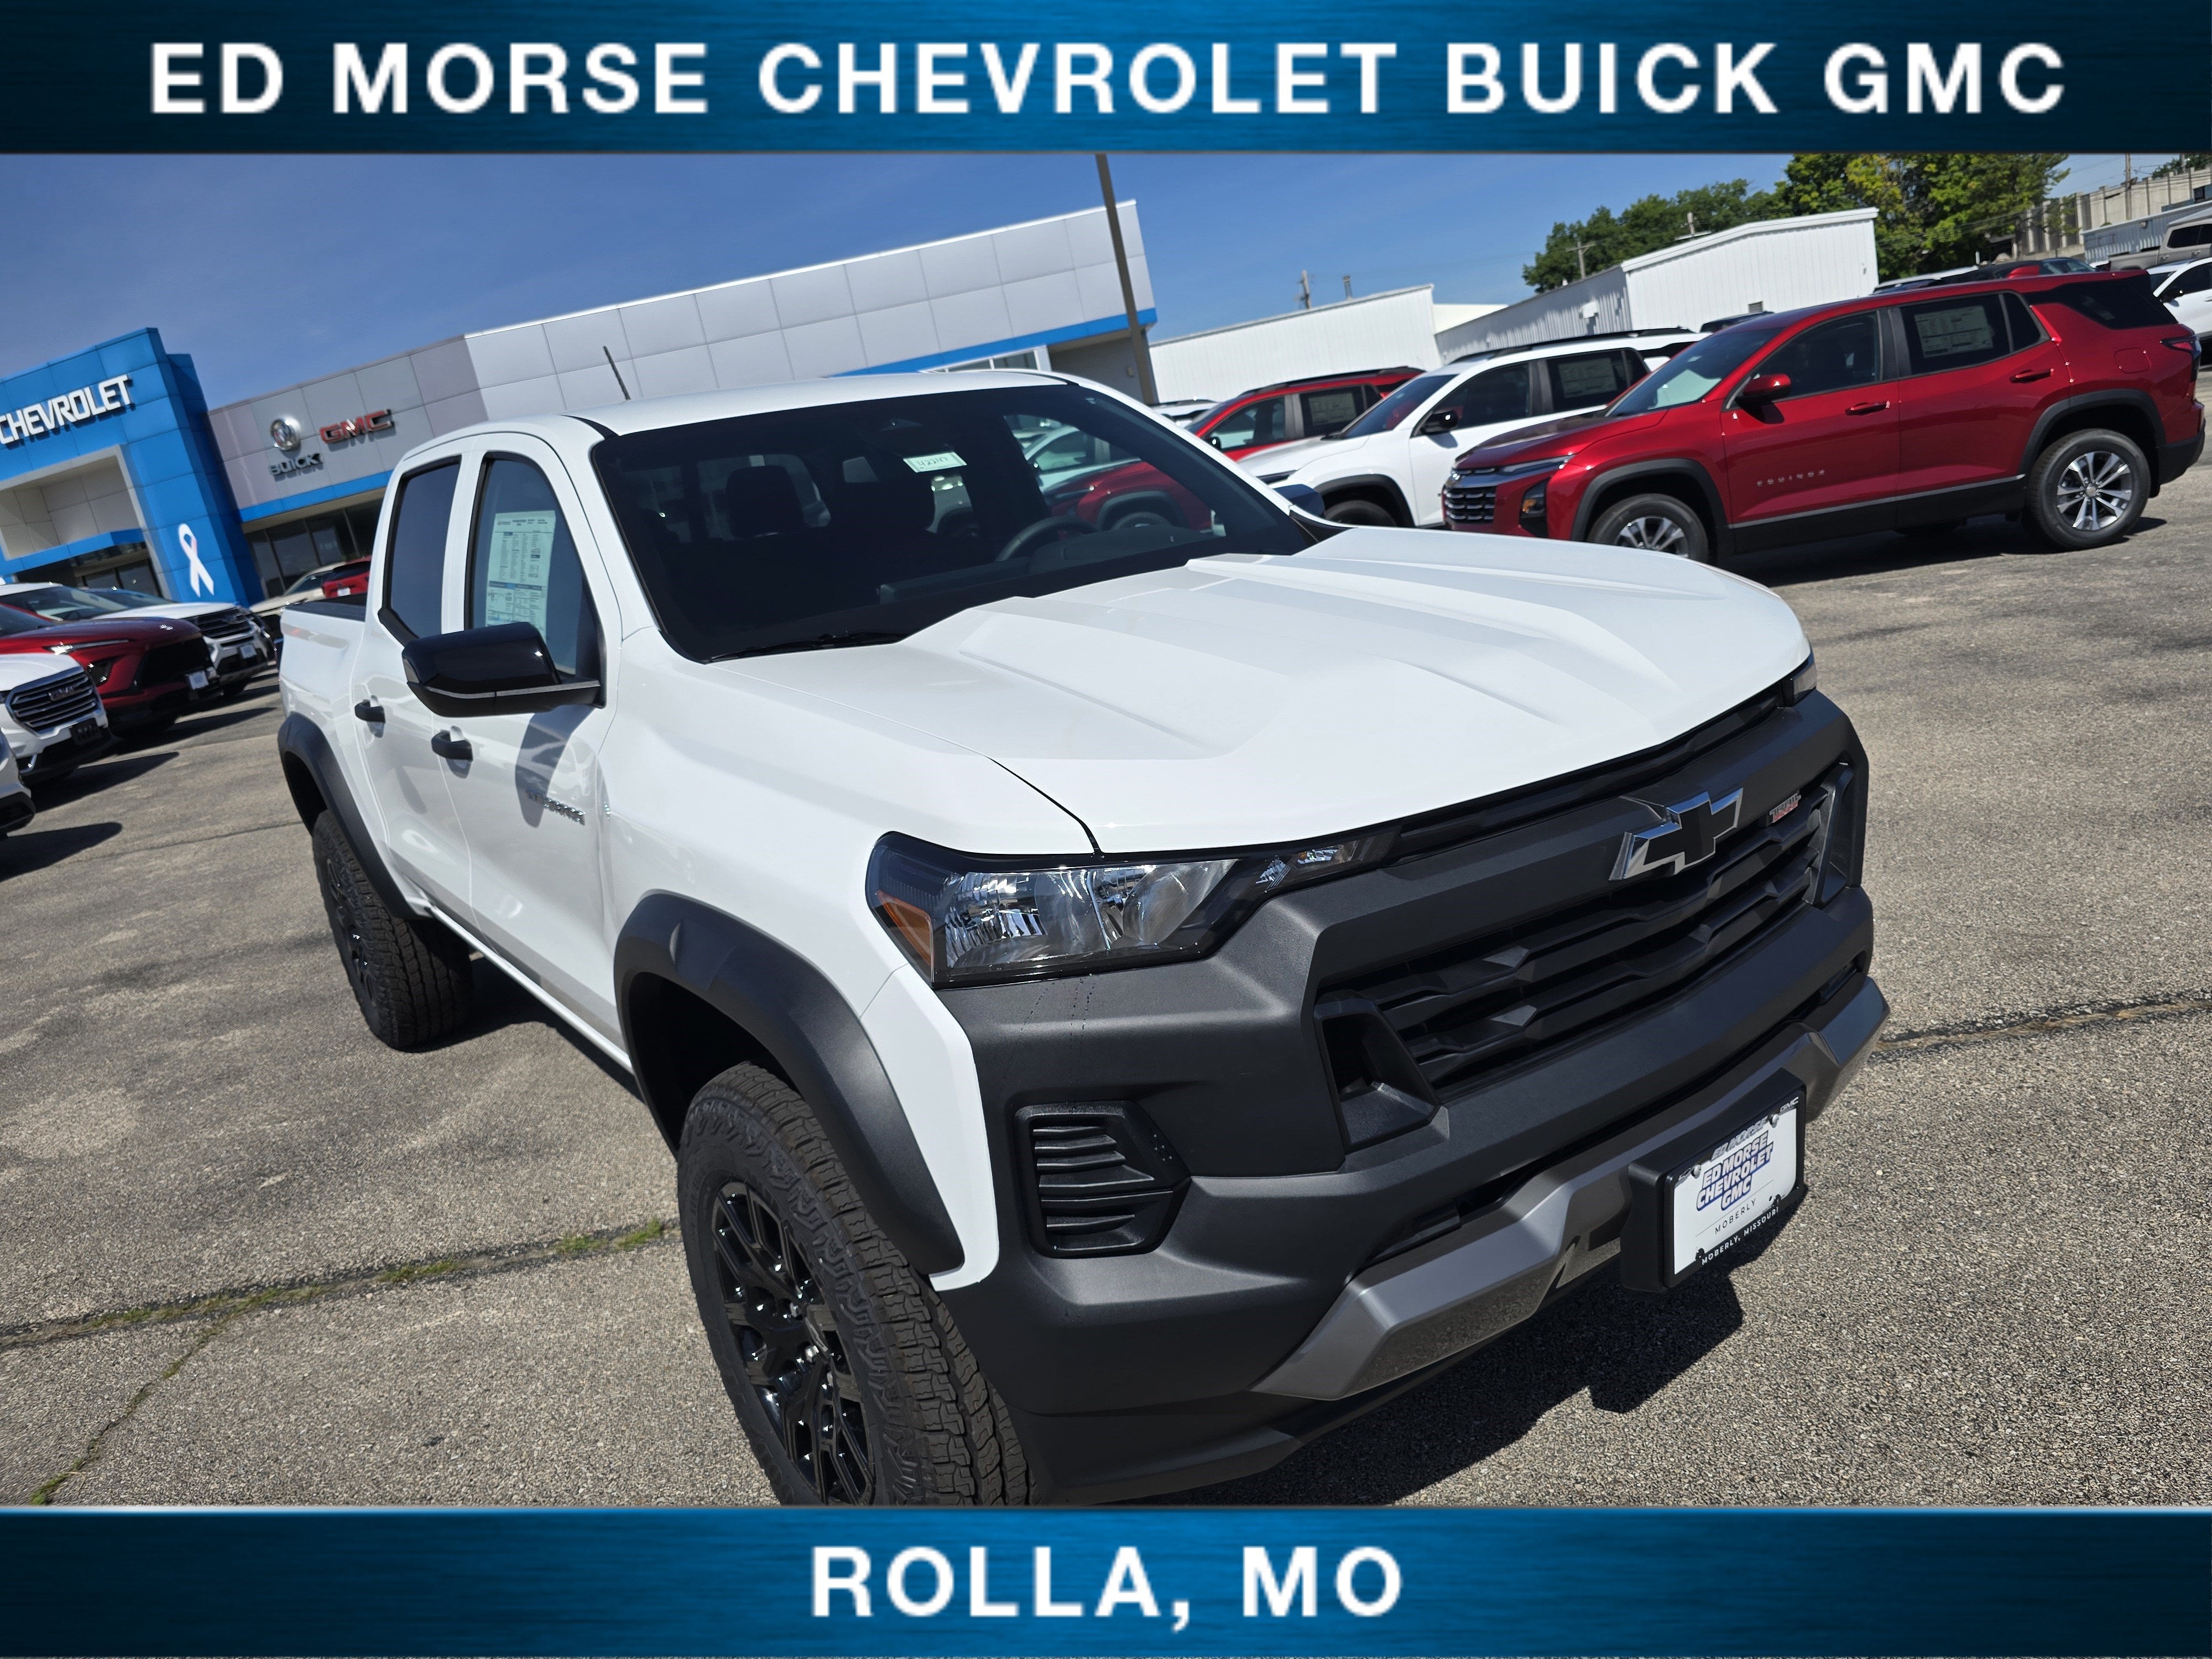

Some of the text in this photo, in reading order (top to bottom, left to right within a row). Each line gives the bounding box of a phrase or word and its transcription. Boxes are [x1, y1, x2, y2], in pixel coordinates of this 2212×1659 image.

[0, 374, 132, 445] CHEVROLET
[319, 409, 392, 445] GMC
[269, 452, 323, 476] BUICK
[1697, 1141, 1774, 1211] CHEVROLET
[1702, 1129, 1769, 1190] ED MORSE
[1721, 1174, 1752, 1211] GMC
[1715, 1198, 1756, 1235] MOBERLY
[1744, 1206, 1780, 1237] MISSOURI
